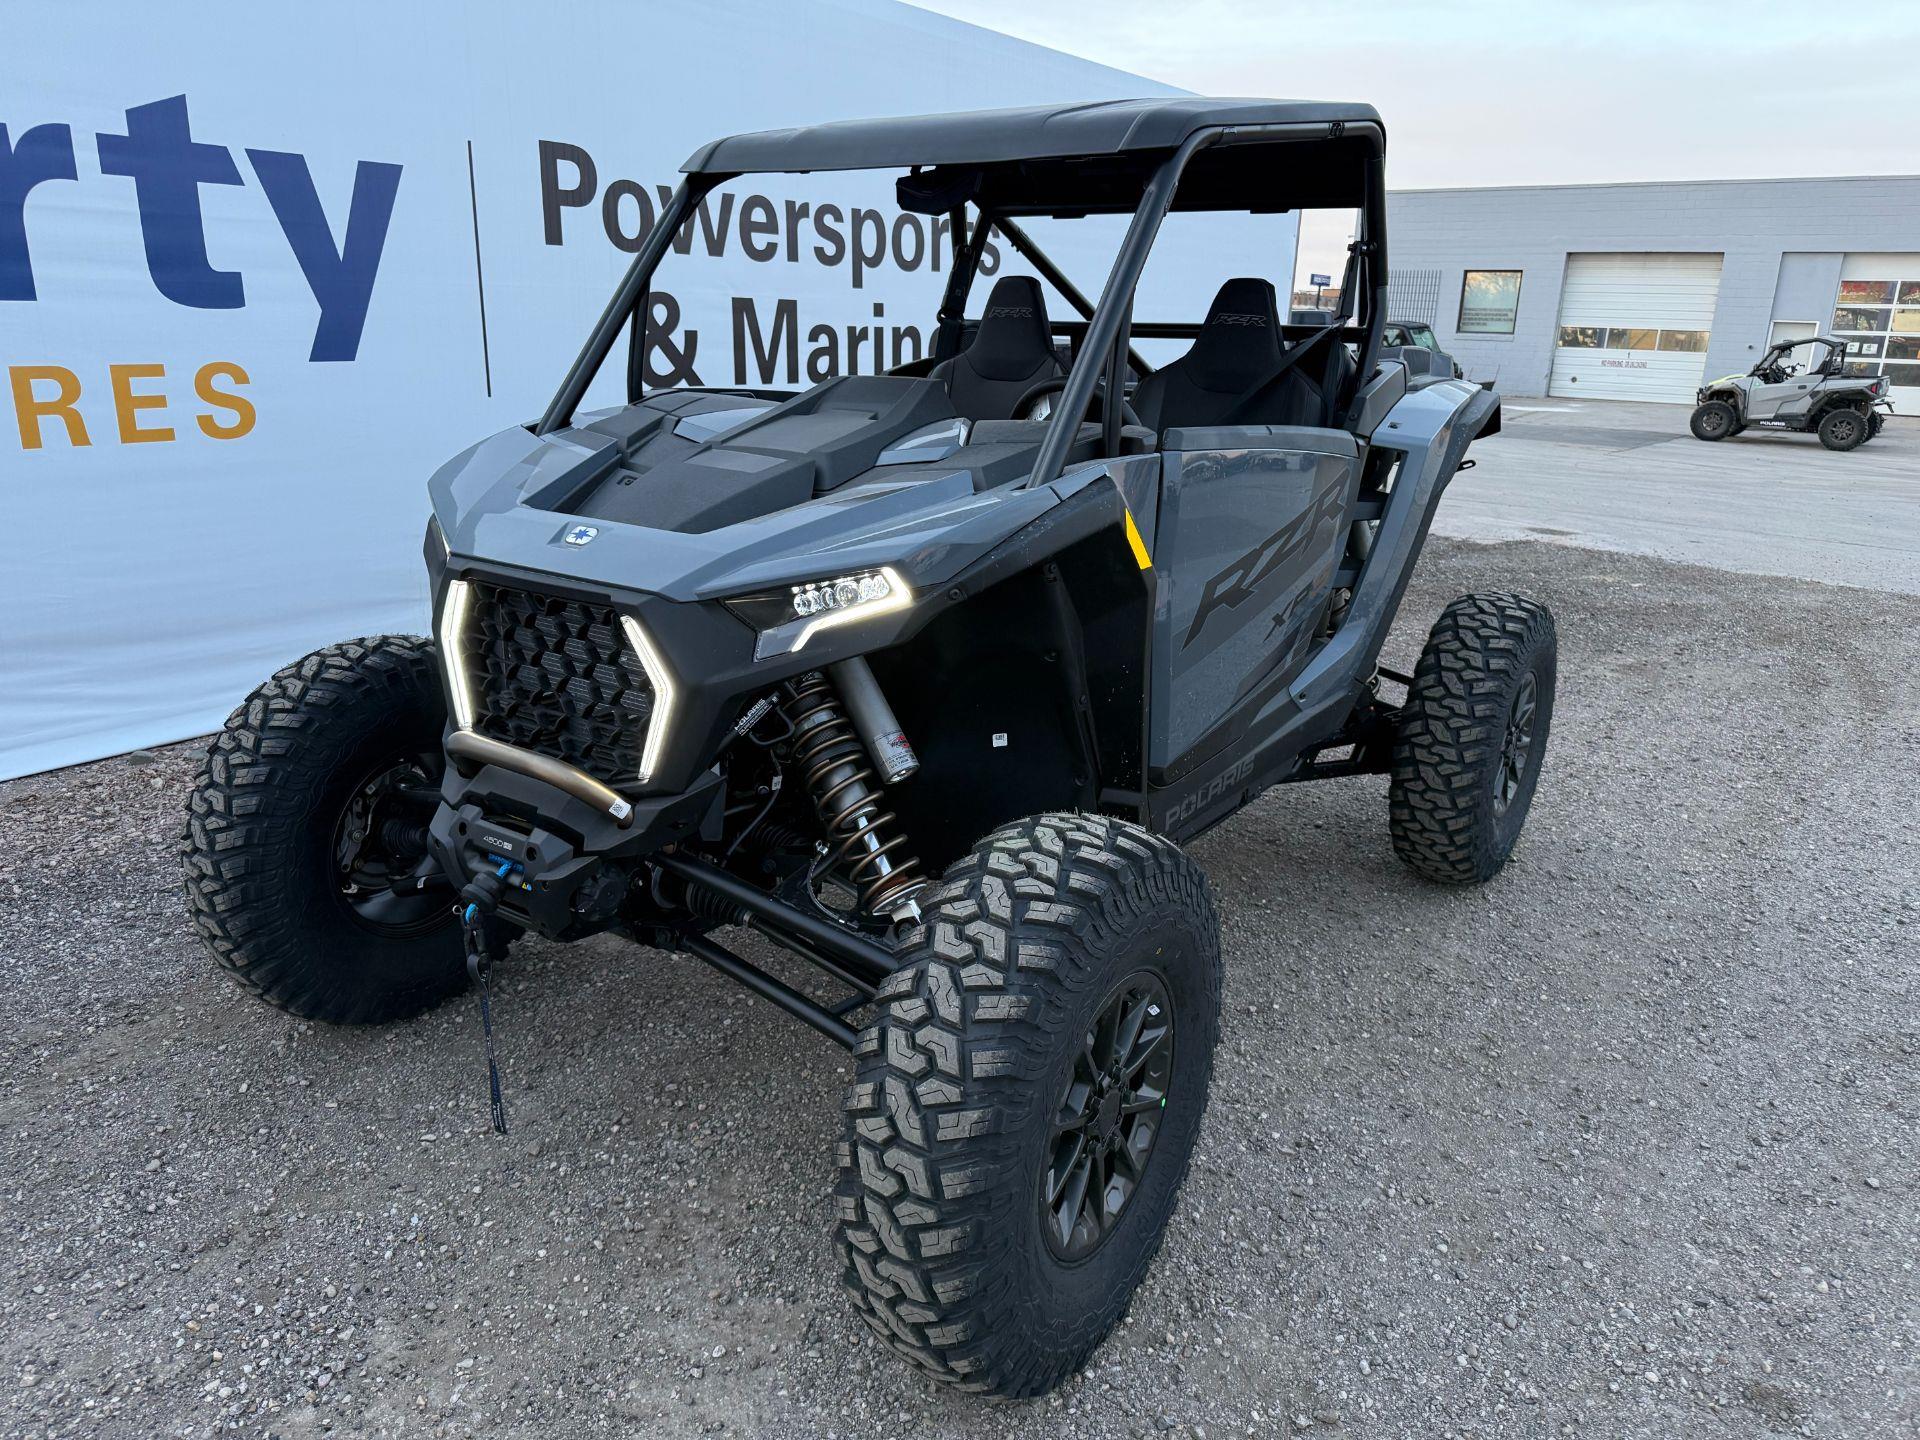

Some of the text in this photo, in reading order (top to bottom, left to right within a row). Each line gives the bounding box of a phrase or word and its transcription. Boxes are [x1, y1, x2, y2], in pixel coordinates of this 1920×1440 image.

[0, 93, 404, 362] rty
[538, 140, 1001, 289] Powerspors
[642, 291, 940, 388] & Marin
[989, 306, 1033, 318] RZR
[1212, 313, 1266, 327] RZR
[8, 361, 257, 450] RES
[1180, 466, 1350, 655] RZR
[1165, 753, 1256, 832] POLARIS
